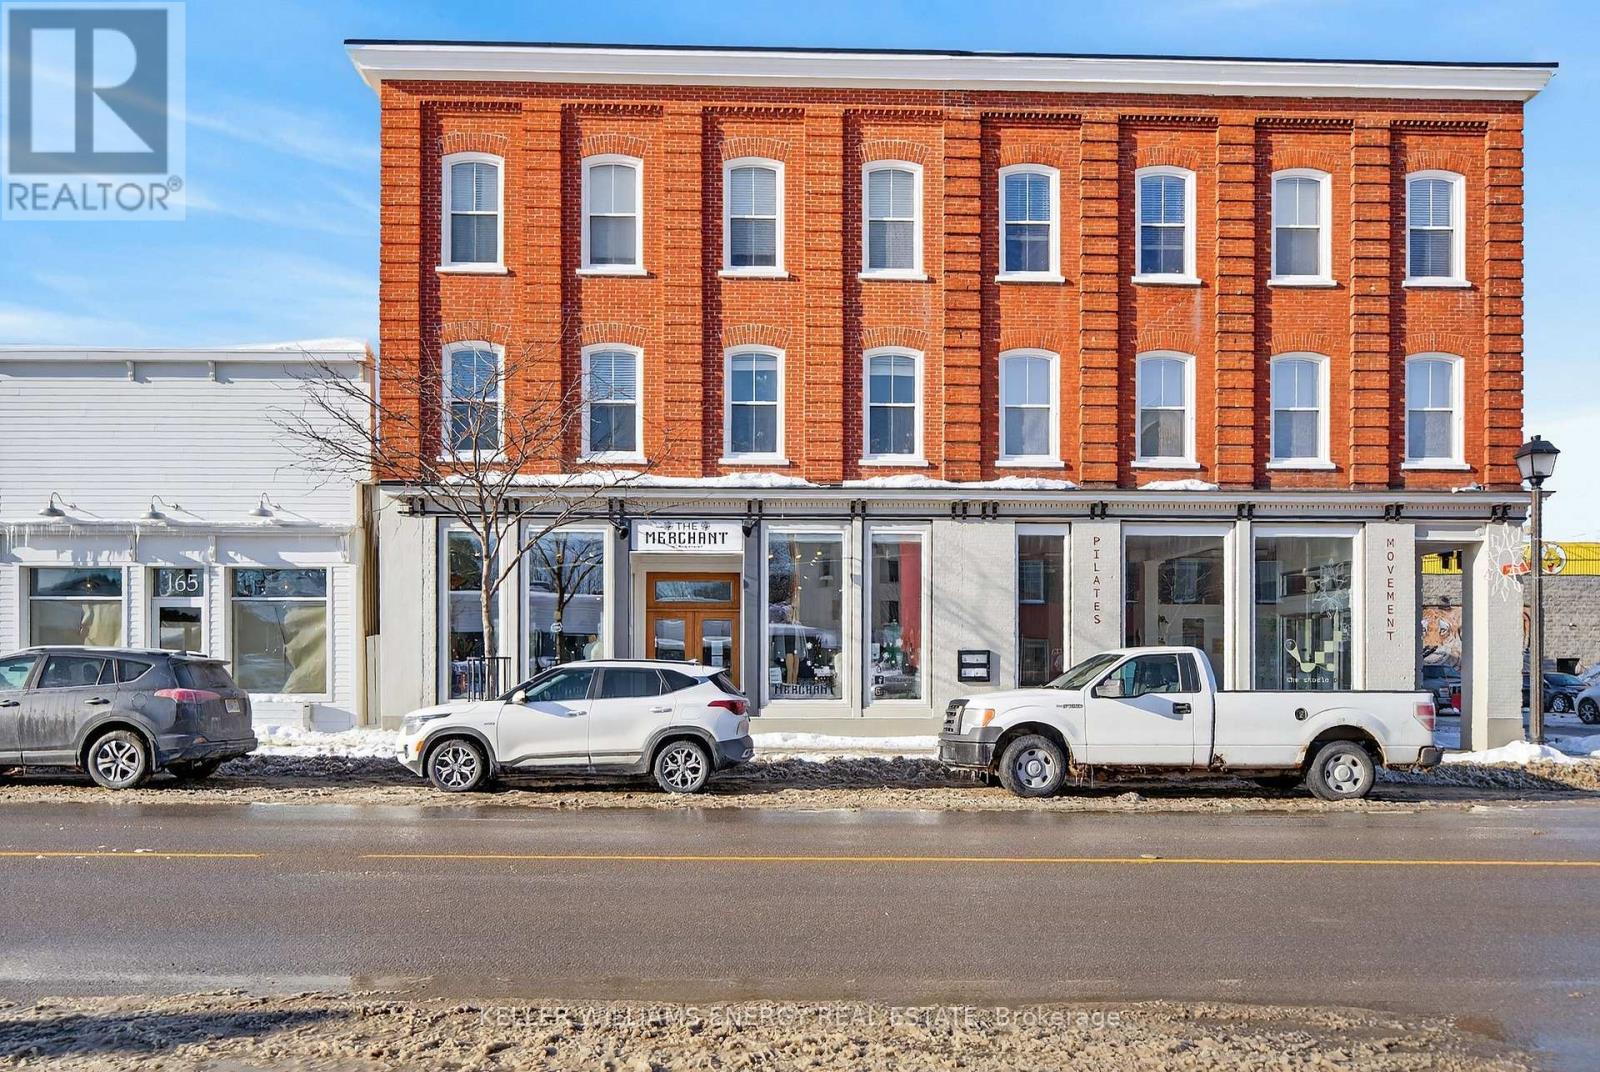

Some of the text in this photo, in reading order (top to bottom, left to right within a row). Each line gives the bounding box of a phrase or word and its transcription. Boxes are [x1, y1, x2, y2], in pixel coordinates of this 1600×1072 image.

[677, 522, 698, 531] THE
[645, 531, 728, 544] MERCHANT
[165, 573, 198, 592] 165
[1093, 536, 1101, 624] PILATES
[1386, 538, 1395, 640] MOVEMENT
